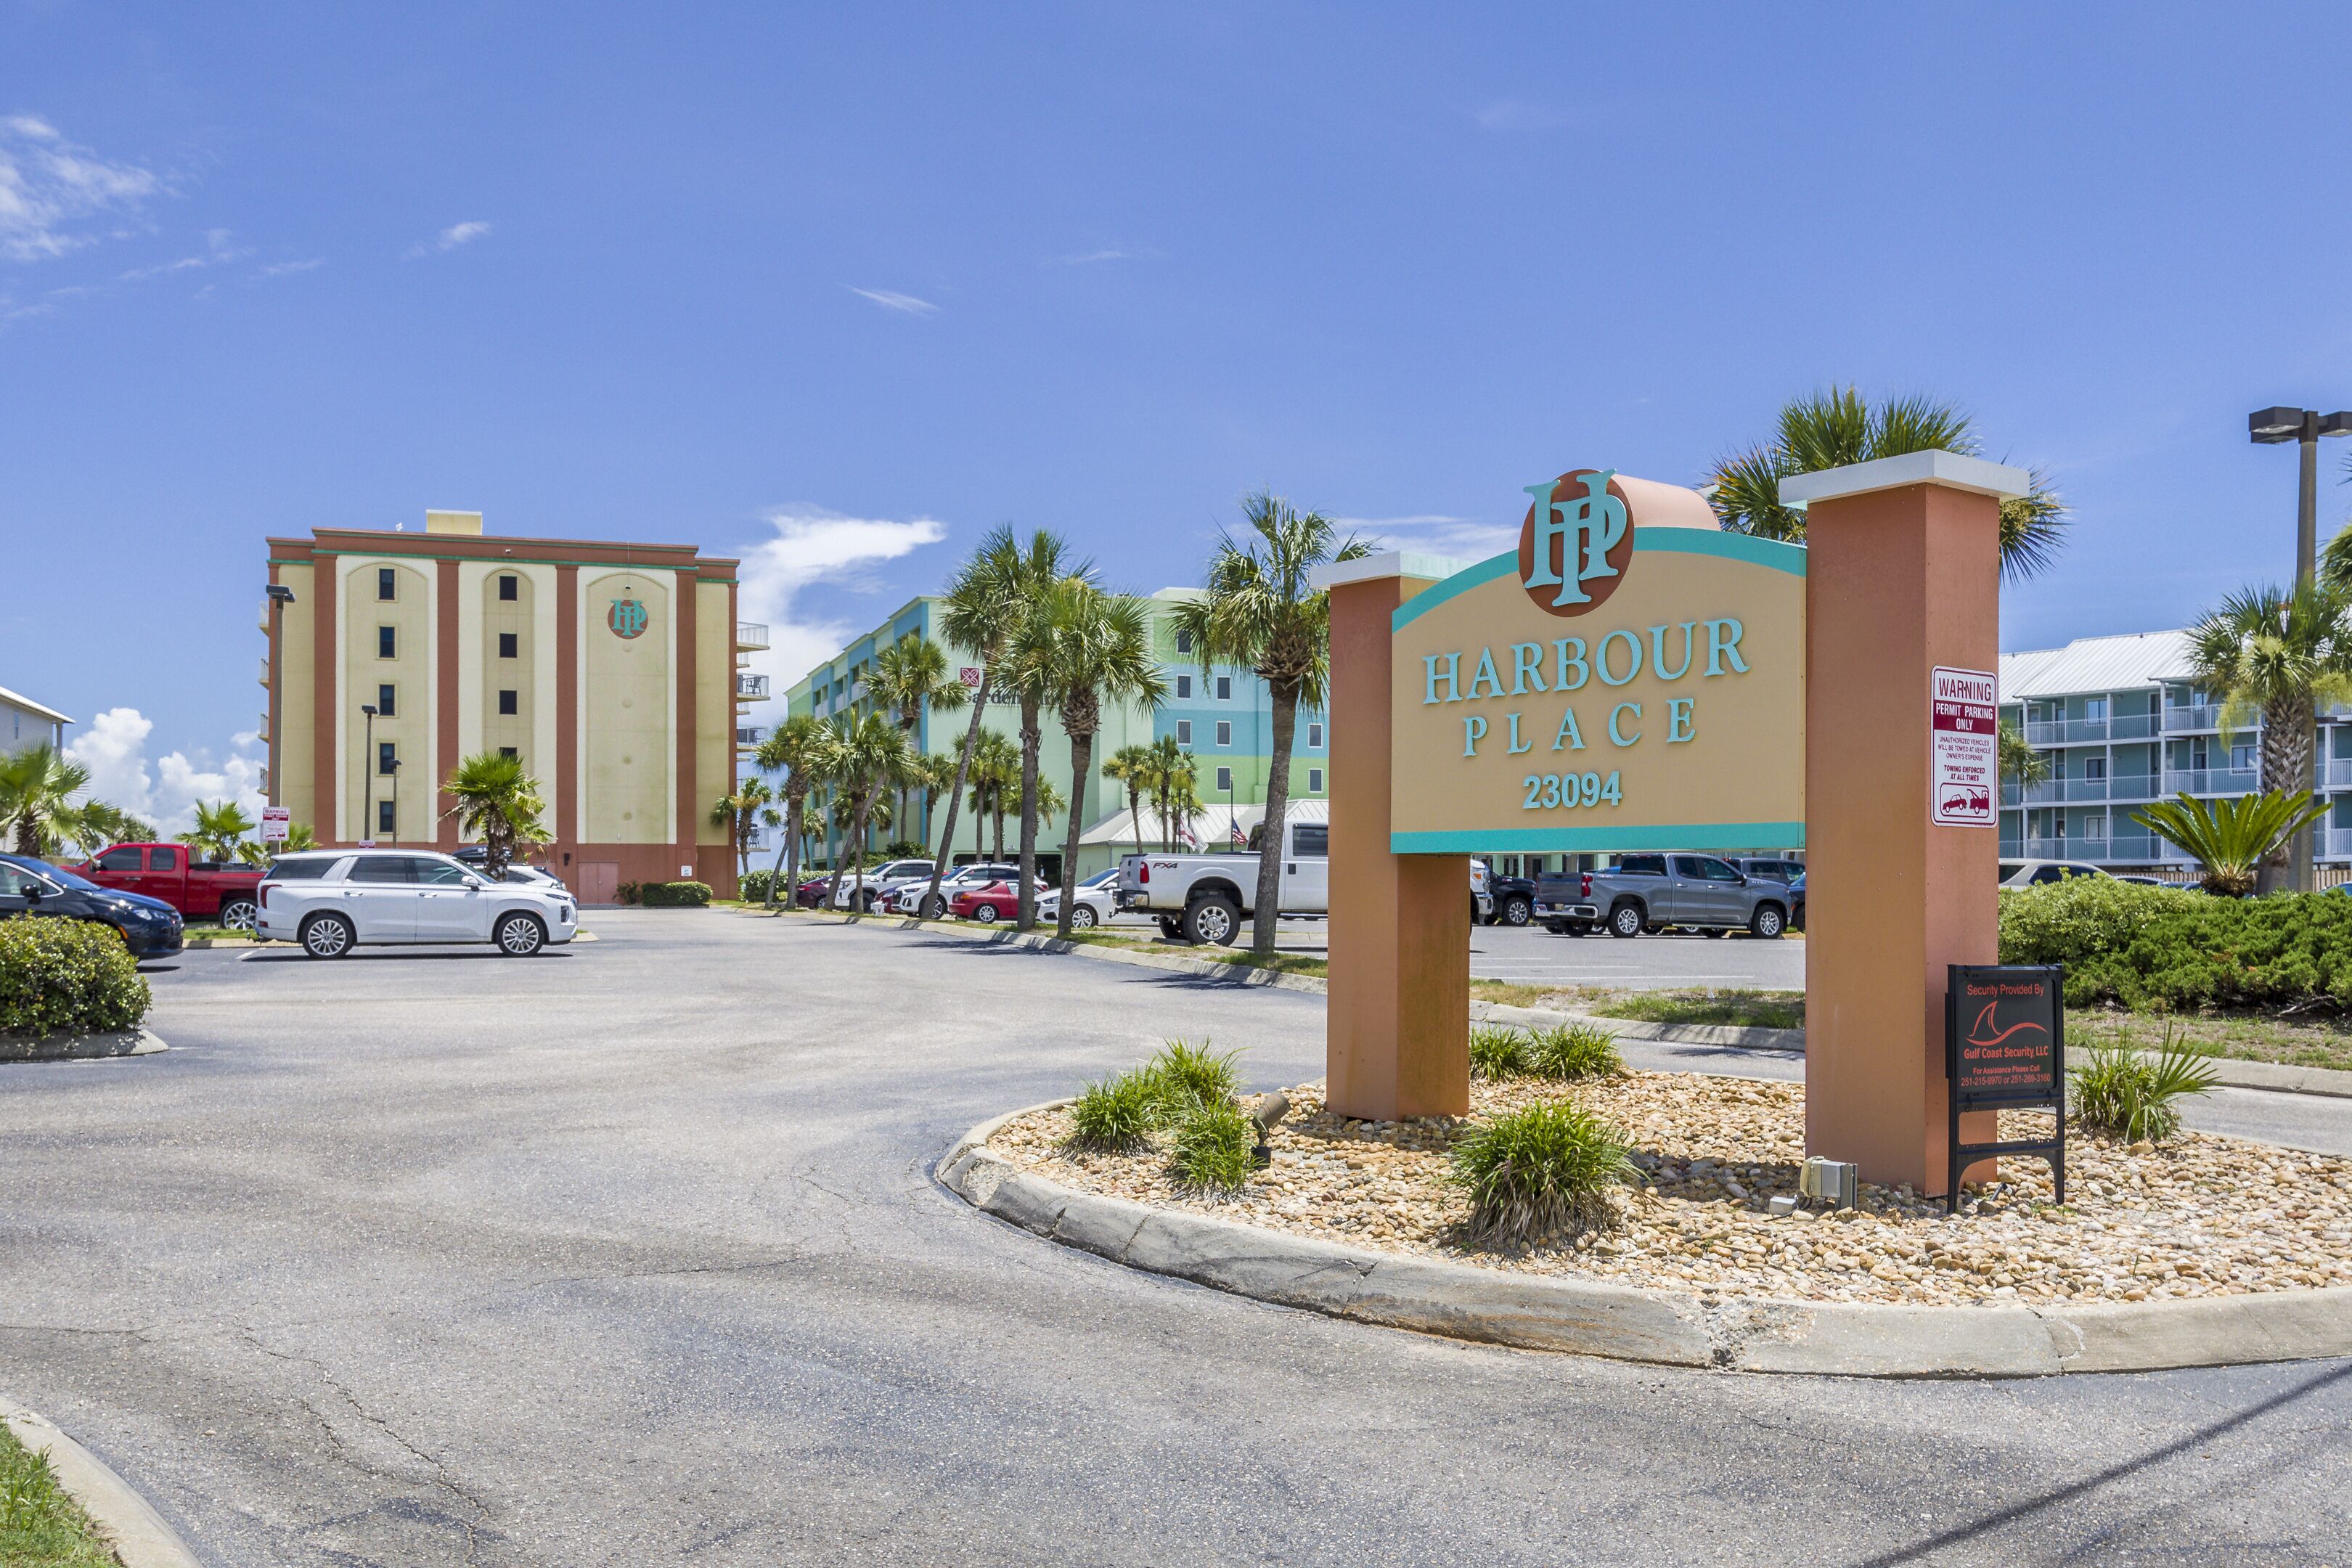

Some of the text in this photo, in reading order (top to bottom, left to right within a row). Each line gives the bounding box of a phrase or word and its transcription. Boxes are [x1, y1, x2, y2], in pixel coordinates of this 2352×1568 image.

[1422, 618, 1750, 705] HARBOUR
[1939, 678, 1991, 702] WARNING
[1936, 702, 1993, 720] PERMIT PARKING
[1463, 698, 1696, 757] PLACE
[1956, 718, 1973, 731] ONLY
[1939, 736, 1970, 745] UNAUTHORIZED
[1523, 770, 1622, 809] 23094
[1967, 983, 2044, 997] Security Provided By
[1964, 1045, 2048, 1059] Gulf Coast Security, LLC
